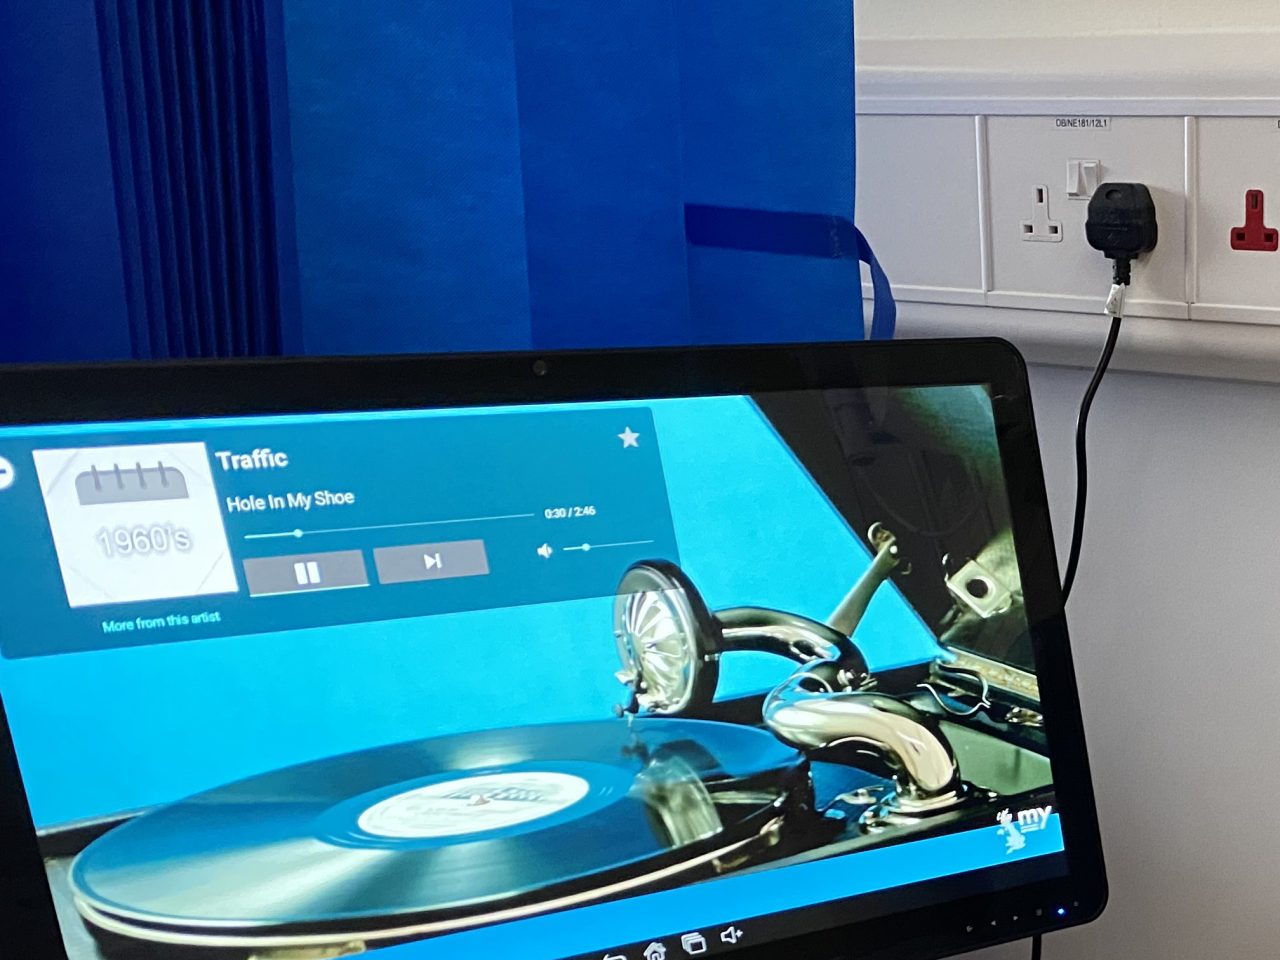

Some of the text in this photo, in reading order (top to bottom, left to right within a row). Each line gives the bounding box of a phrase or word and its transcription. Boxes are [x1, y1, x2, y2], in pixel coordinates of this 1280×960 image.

[214, 448, 289, 471] Traffic
[226, 490, 356, 513] Hole In My Shoe
[544, 507, 567, 519] 0:30
[98, 523, 192, 557] 1960's
[102, 611, 222, 633] More from this artist
[1017, 805, 1053, 831] my
